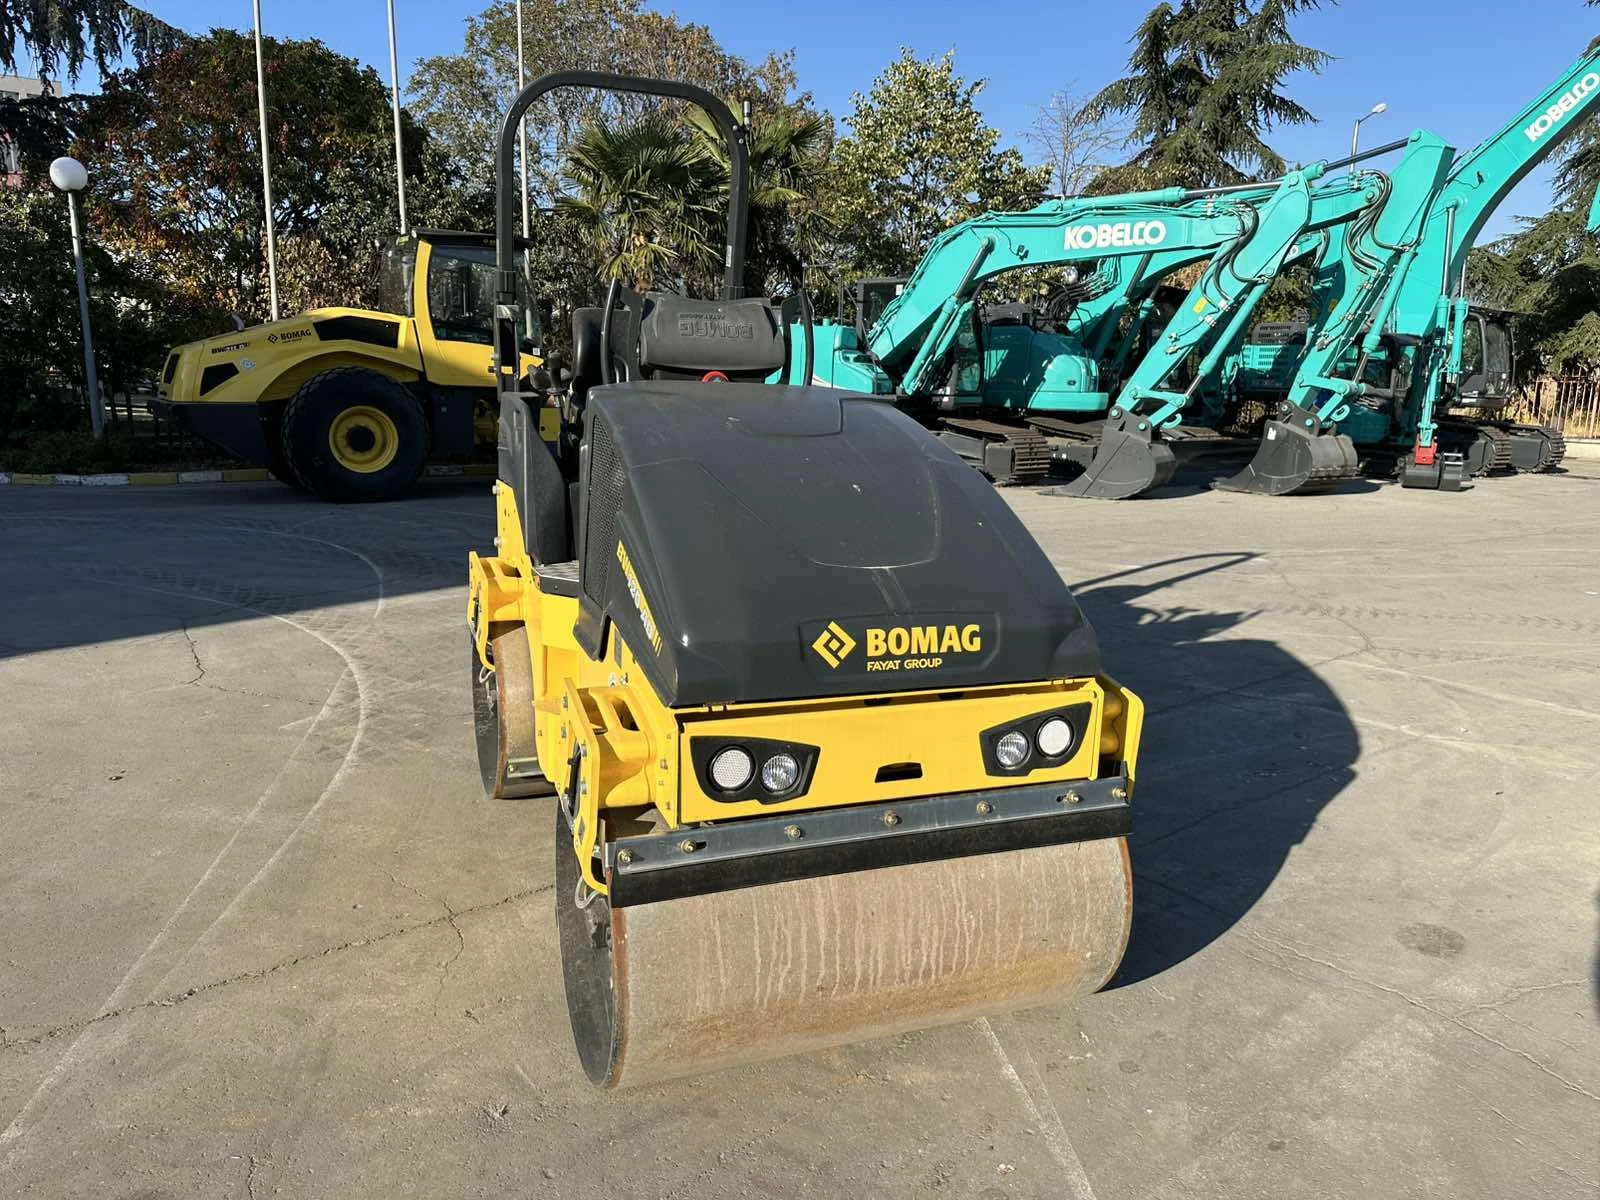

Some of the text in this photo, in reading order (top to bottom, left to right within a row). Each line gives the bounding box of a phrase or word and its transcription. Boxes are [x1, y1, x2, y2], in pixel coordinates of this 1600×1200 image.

[1524, 72, 1600, 142] KOBELCO
[1064, 220, 1167, 250] KOBELCO
[280, 329, 311, 340] BOMAG
[679, 321, 753, 338] BOMAG
[866, 624, 981, 657] BOMAG
[867, 658, 942, 671] FAYAT GROUP
